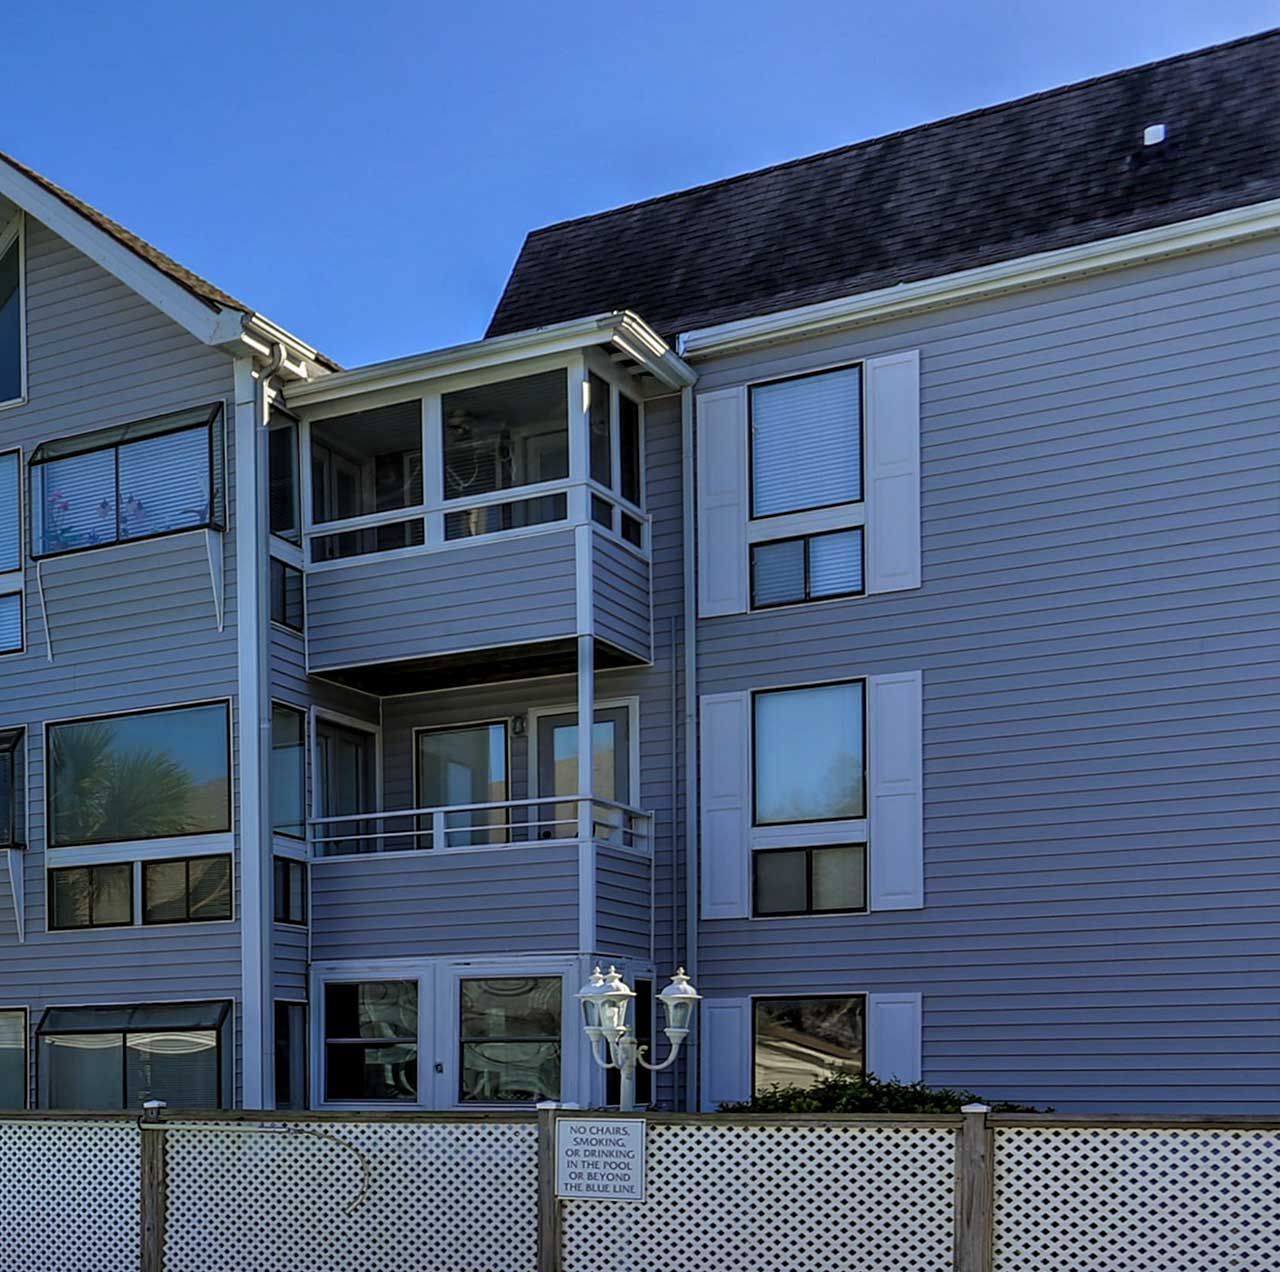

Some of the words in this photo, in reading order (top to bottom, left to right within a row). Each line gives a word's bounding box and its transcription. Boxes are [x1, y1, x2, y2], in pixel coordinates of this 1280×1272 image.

[570, 1126, 587, 1135] NO
[565, 1148, 580, 1158] OR
[584, 1149, 635, 1159] DRINKING
[567, 1160, 578, 1169] IN
[582, 1160, 600, 1169] THE
[603, 1161, 632, 1170] POOL
[569, 1171, 584, 1180] OR
[587, 1172, 631, 1182] BEYOND
[564, 1182, 582, 1191] THE
[586, 1183, 610, 1193] BLUE
[613, 1184, 636, 1194] LINE
